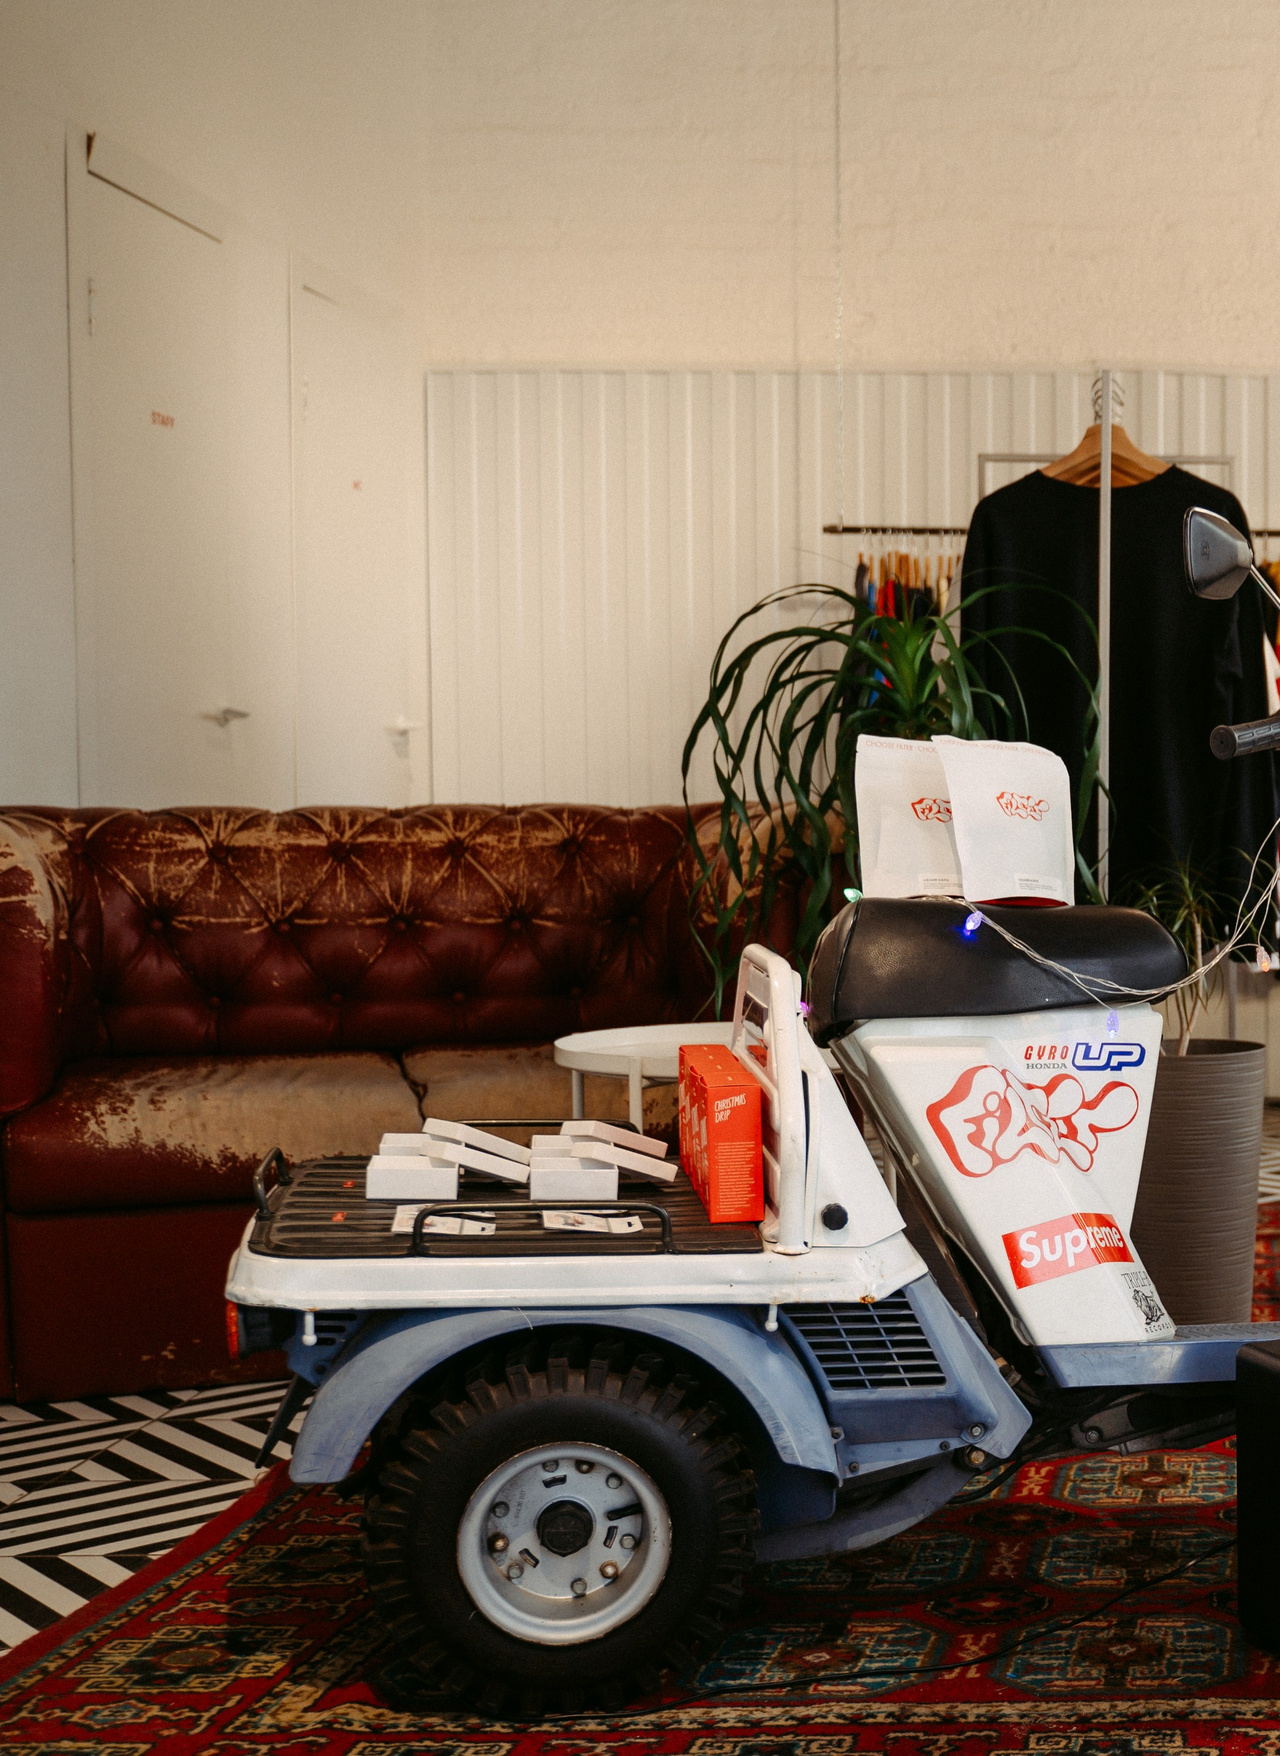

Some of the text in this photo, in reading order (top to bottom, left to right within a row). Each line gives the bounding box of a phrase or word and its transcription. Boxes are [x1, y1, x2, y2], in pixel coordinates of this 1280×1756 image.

[866, 740, 894, 749] CHOOSE
[897, 743, 913, 751] FILTER
[1024, 1042, 1146, 1071] GYRO UP
[1026, 1062, 1068, 1070] HONDA
[714, 1093, 747, 1112] CHRISTMAS
[714, 1109, 731, 1123] DRIP
[1019, 1225, 1124, 1269] Supreme
